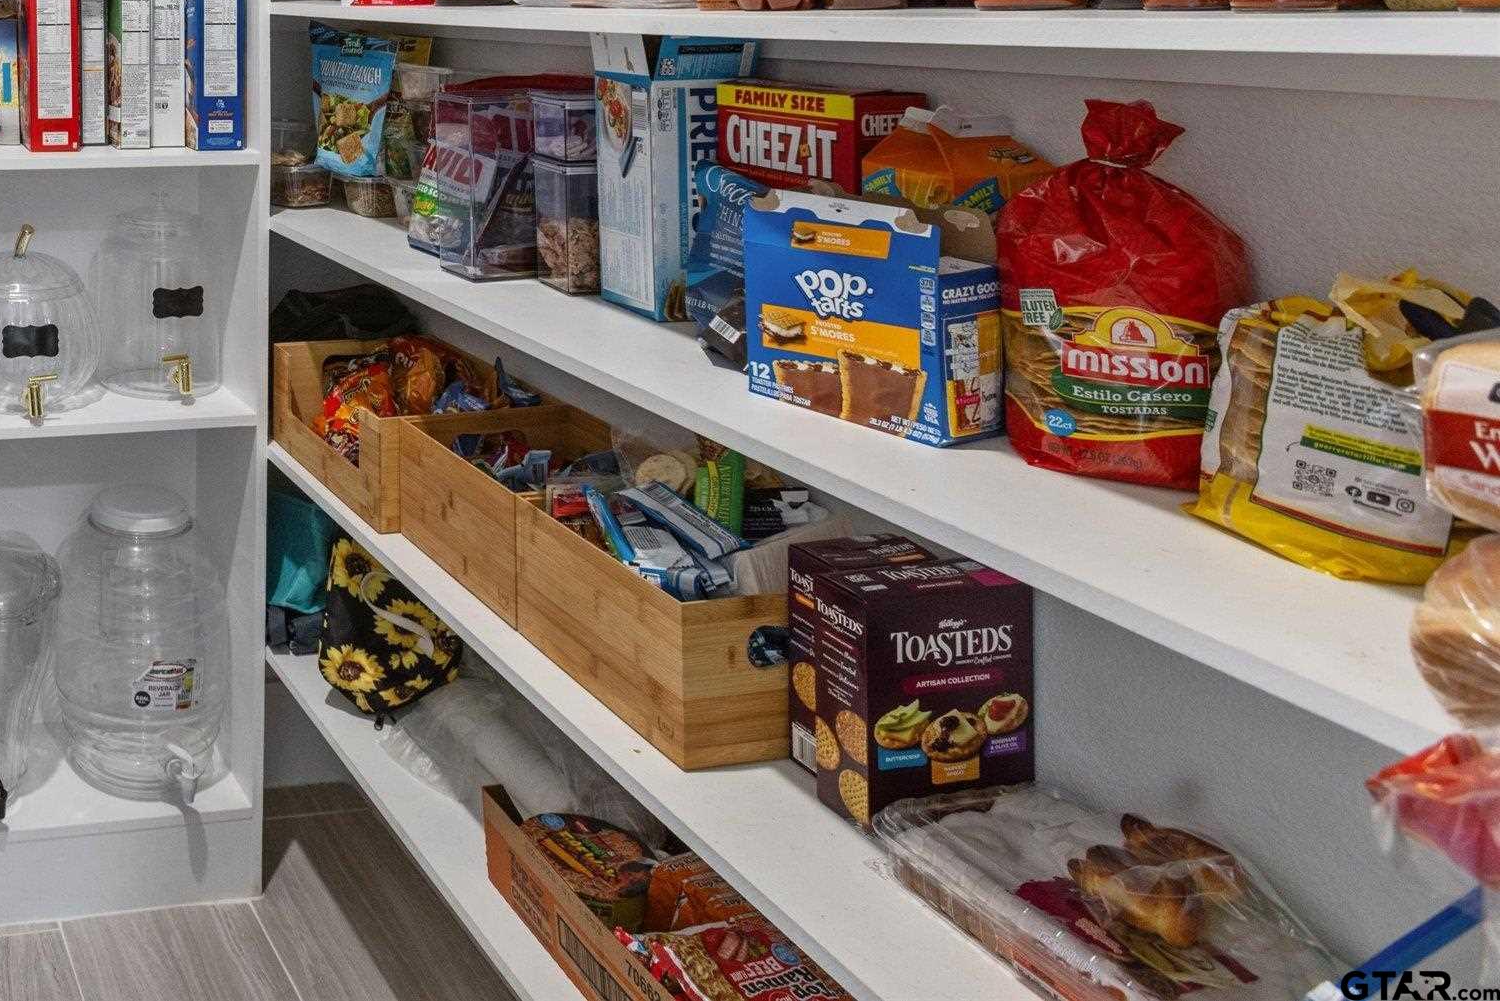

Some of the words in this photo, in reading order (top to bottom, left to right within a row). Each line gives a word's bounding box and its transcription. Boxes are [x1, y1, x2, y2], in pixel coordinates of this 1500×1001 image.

[734, 89, 788, 109] FAMILY
[790, 93, 826, 113] SIZE
[942, 283, 976, 300] CRAZY
[811, 297, 864, 318] tarts
[810, 326, 856, 342] S'MORES
[751, 361, 770, 379] 12
[1067, 349, 1204, 384] mission
[1073, 385, 1122, 402] Estilo
[1127, 391, 1192, 402] Casero
[1101, 405, 1167, 415] TOSTADAS
[816, 598, 864, 635] TOASTEDS
[891, 625, 1014, 667] TOASTEDS
[916, 678, 946, 688] ARTISAN
[948, 674, 990, 685] COLLECTION
[749, 956, 783, 976] BEEF
[740, 966, 815, 996] Ramen
